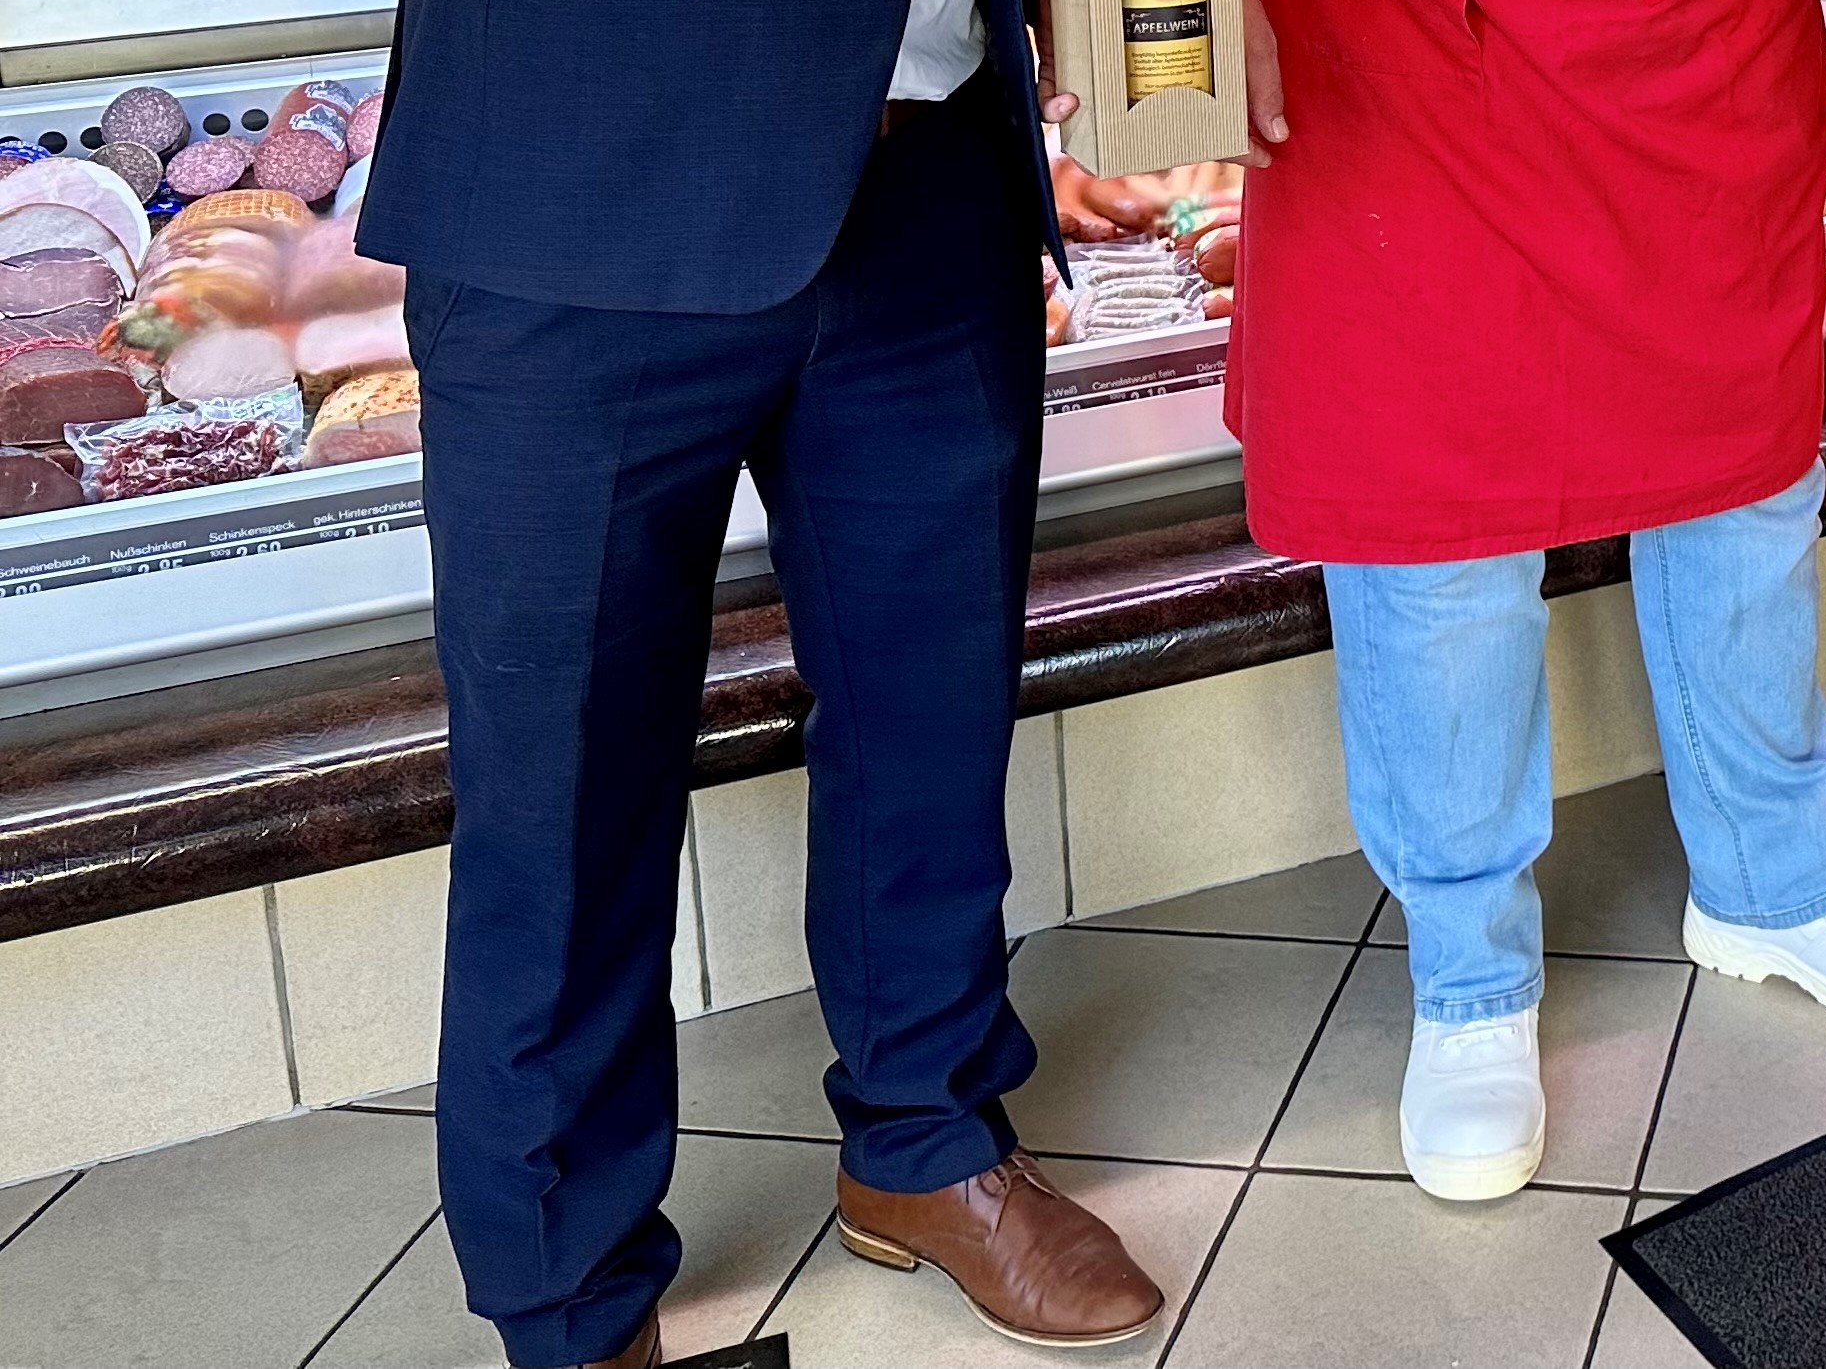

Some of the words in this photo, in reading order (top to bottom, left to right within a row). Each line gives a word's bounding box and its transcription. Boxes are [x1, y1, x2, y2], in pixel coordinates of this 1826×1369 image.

[1133, 18, 1199, 34] APFELWEIN
[110, 538, 187, 560] Nußschinken
[208, 519, 296, 544] Schinkenspeck
[338, 498, 422, 521] Hinterschinken
